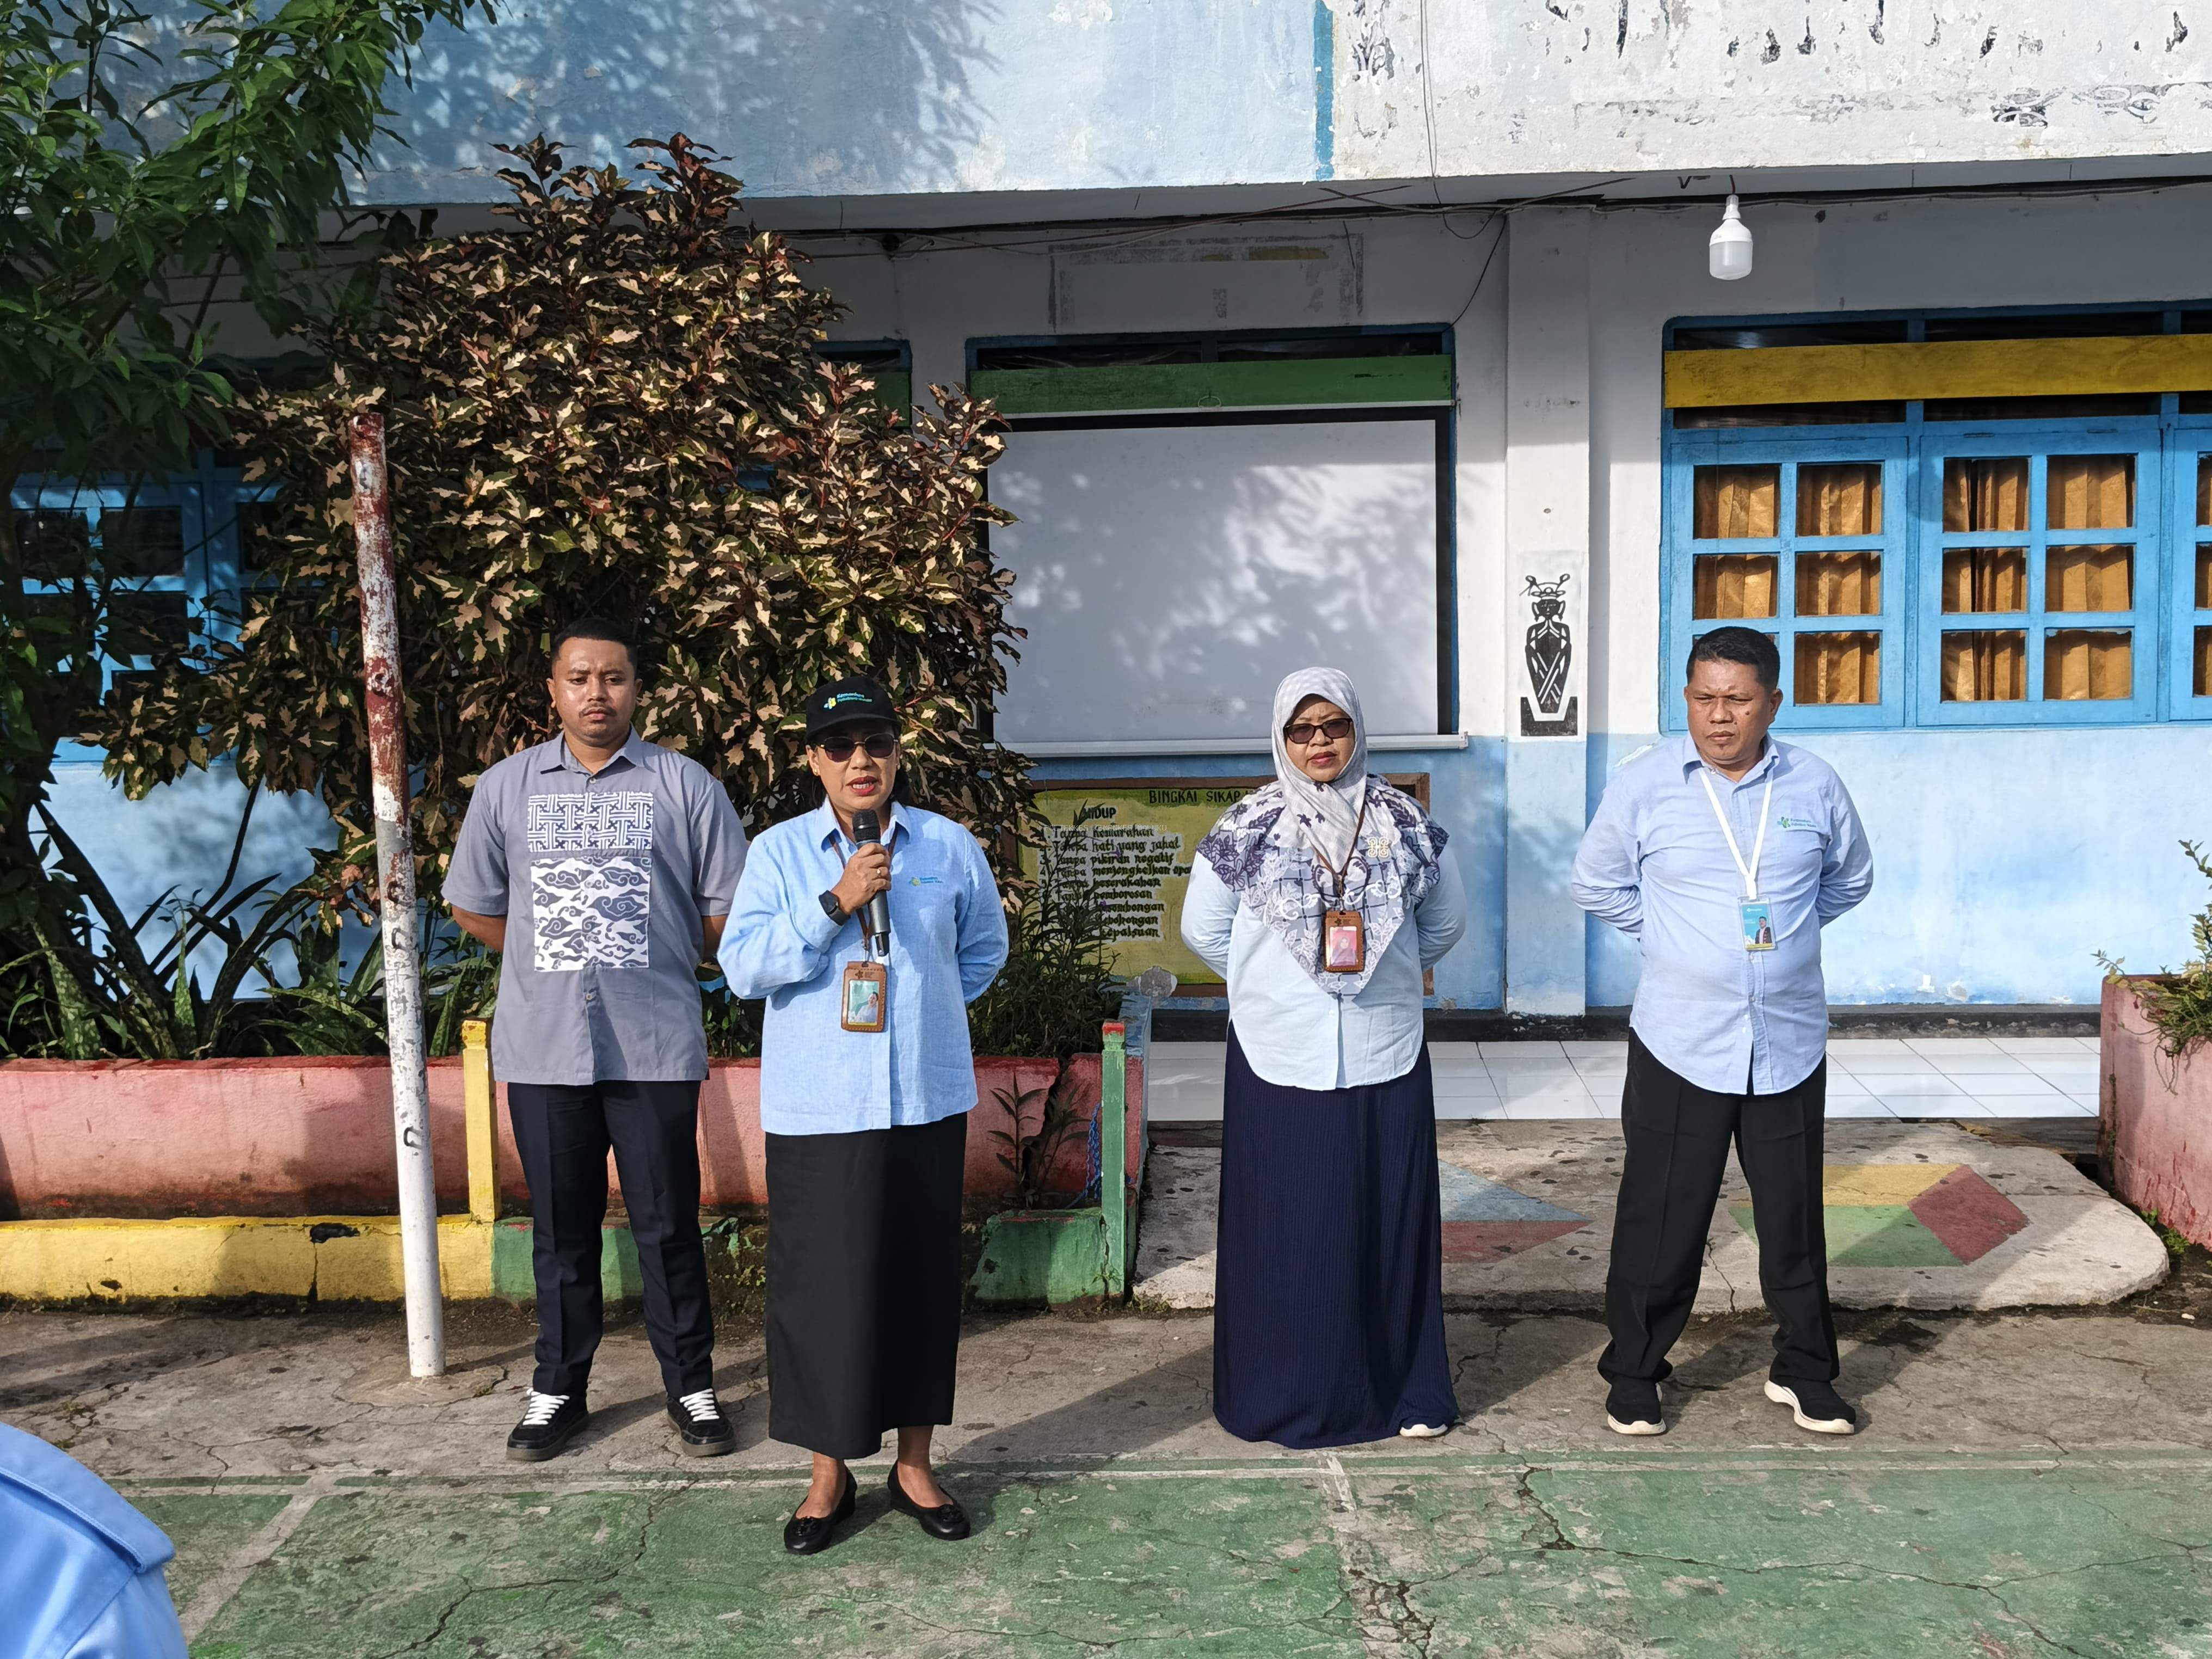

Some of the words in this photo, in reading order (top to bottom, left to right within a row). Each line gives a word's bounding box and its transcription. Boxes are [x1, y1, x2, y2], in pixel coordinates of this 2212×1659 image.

[1149, 790, 1197, 804] BINGKAI
[1206, 790, 1241, 803] SIKAP
[1092, 839, 1114, 852] hati
[1096, 900, 1165, 913] sombongan
